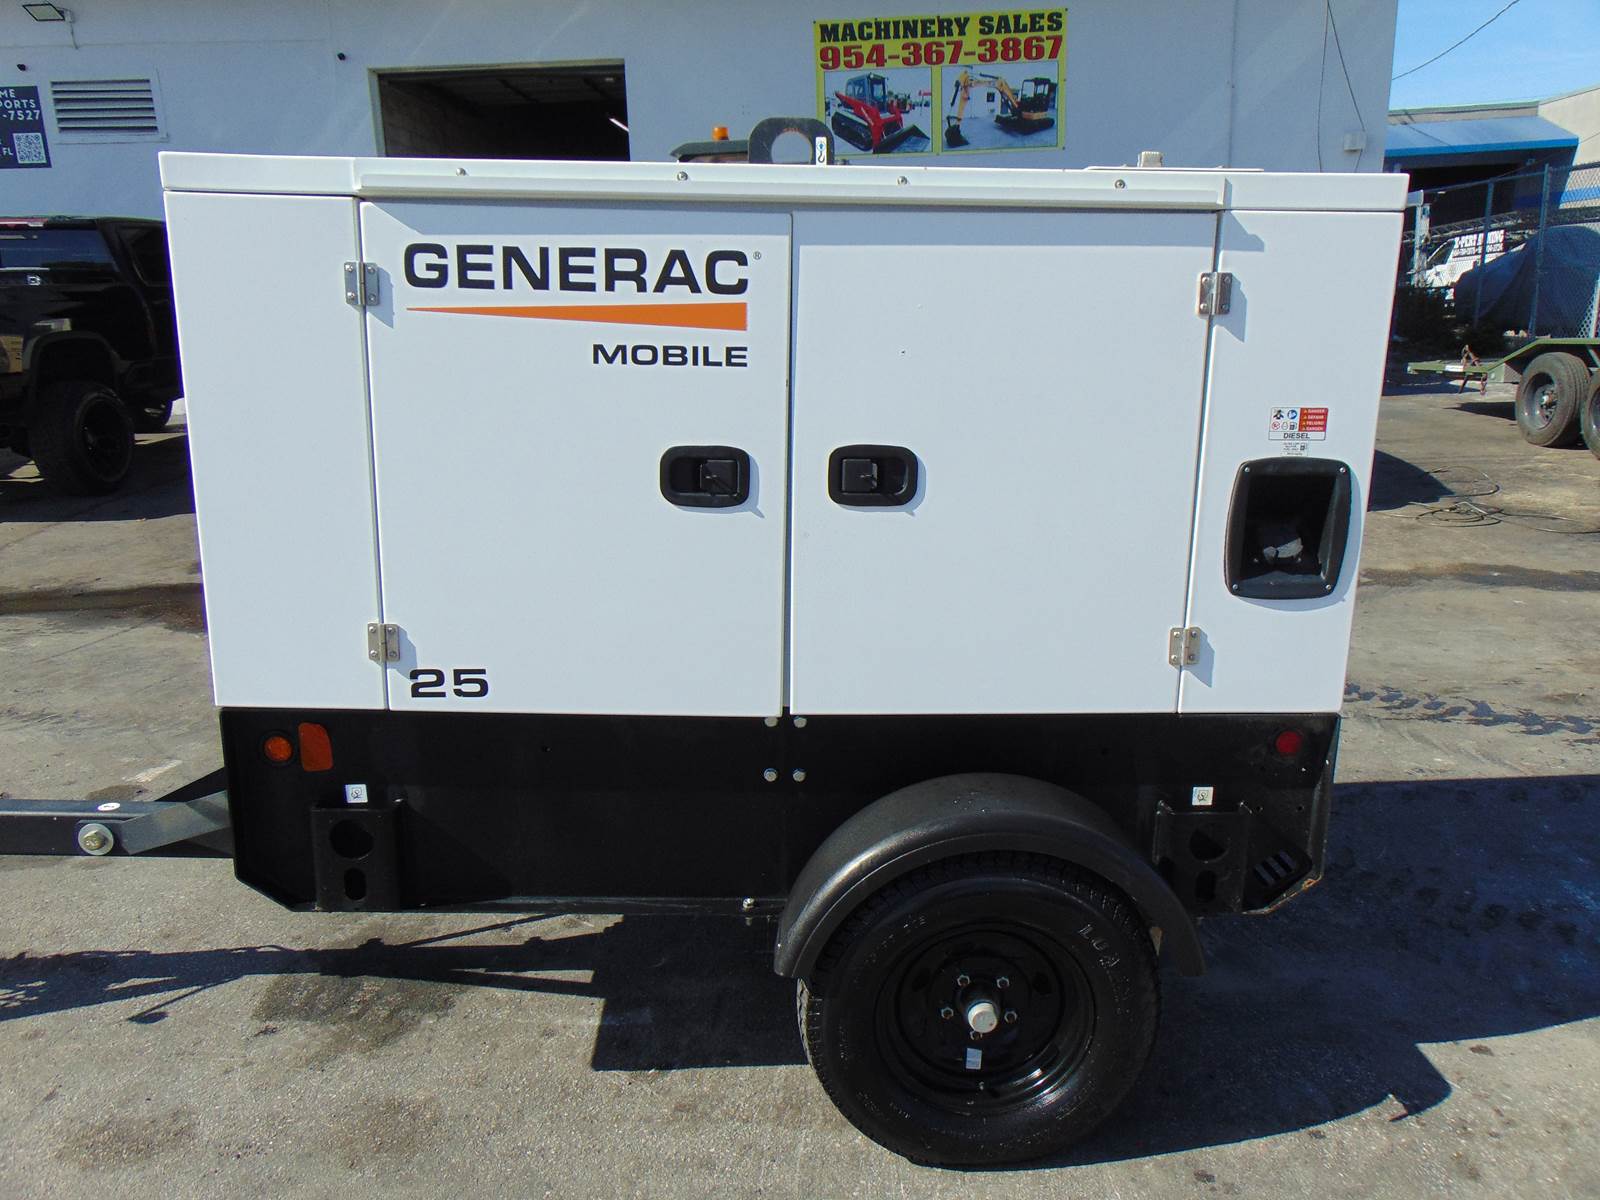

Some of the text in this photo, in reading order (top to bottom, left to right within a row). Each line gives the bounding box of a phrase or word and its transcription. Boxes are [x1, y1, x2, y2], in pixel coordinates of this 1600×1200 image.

[820, 12, 1063, 43] MACHINERY SALES
[820, 35, 1063, 70] 954-367-3867
[404, 243, 749, 295] GENERAC
[592, 343, 748, 367] MOBILE
[409, 668, 489, 698] 25
